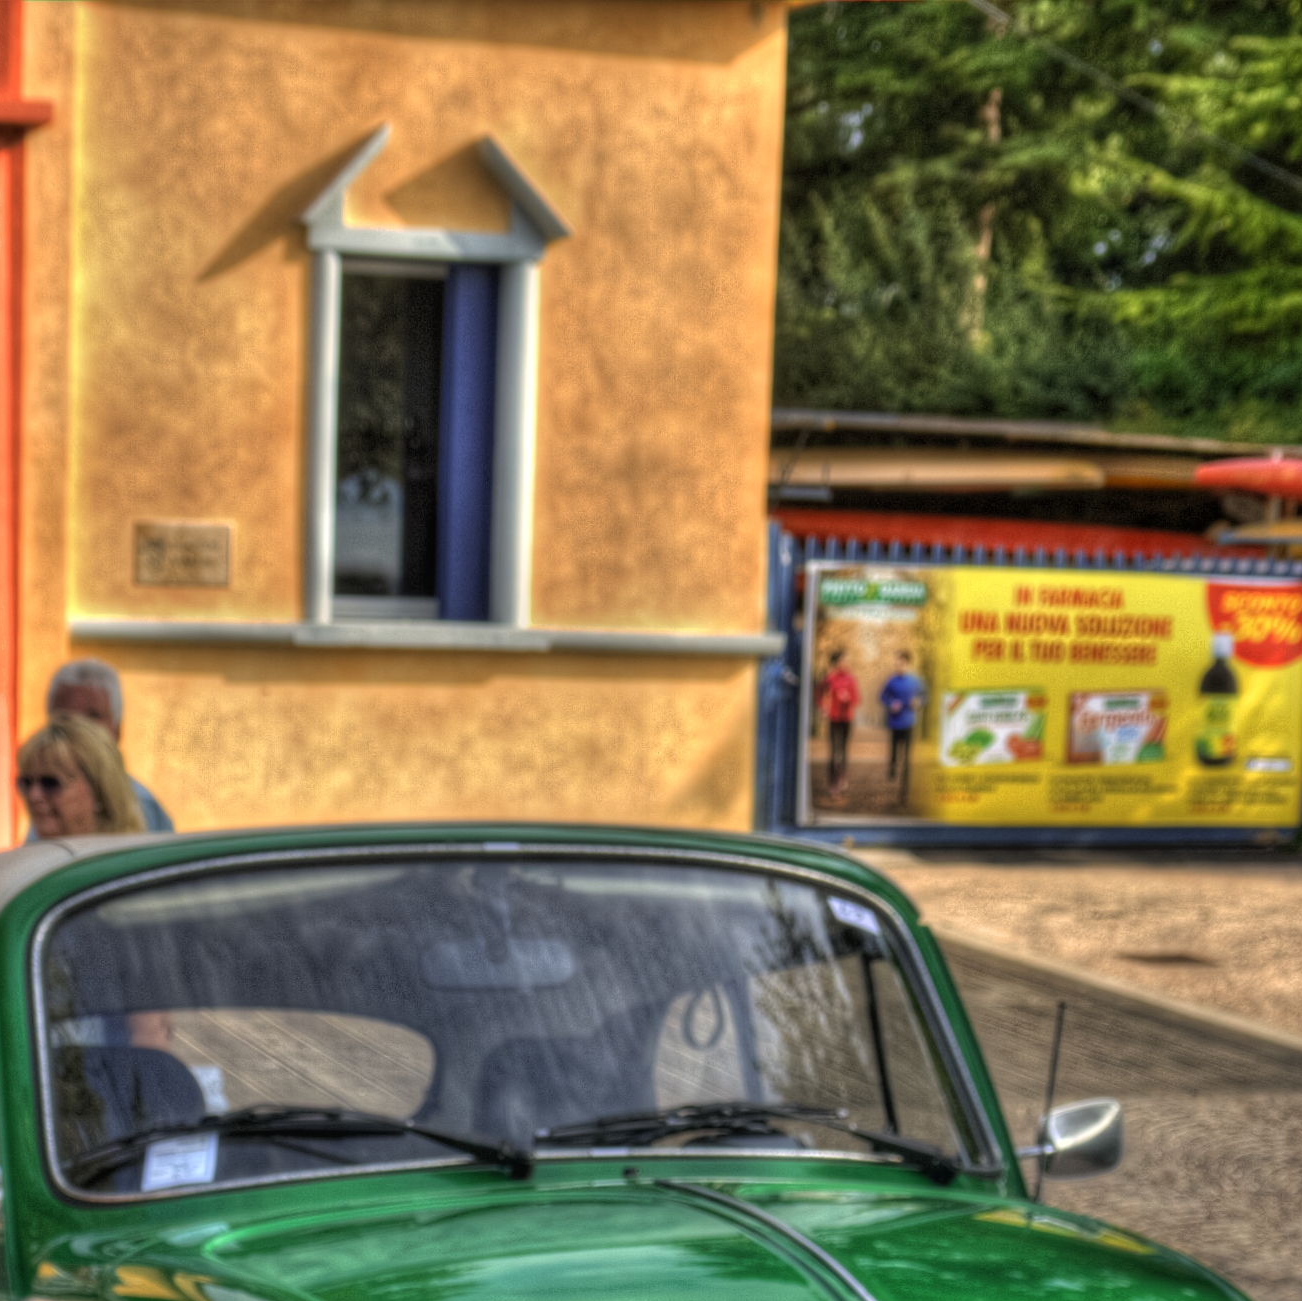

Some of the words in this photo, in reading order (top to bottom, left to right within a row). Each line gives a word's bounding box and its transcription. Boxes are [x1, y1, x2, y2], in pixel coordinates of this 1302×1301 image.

[1016, 586, 1032, 606] IN
[1039, 587, 1123, 609] FARMACIA
[960, 612, 997, 634] UNA
[1005, 613, 1069, 637] NUOVA
[1075, 615, 1173, 641] SOLUZIONE
[972, 638, 1004, 661] PER
[1030, 640, 1064, 664] TUO
[1069, 642, 1157, 666] BENESSERE
